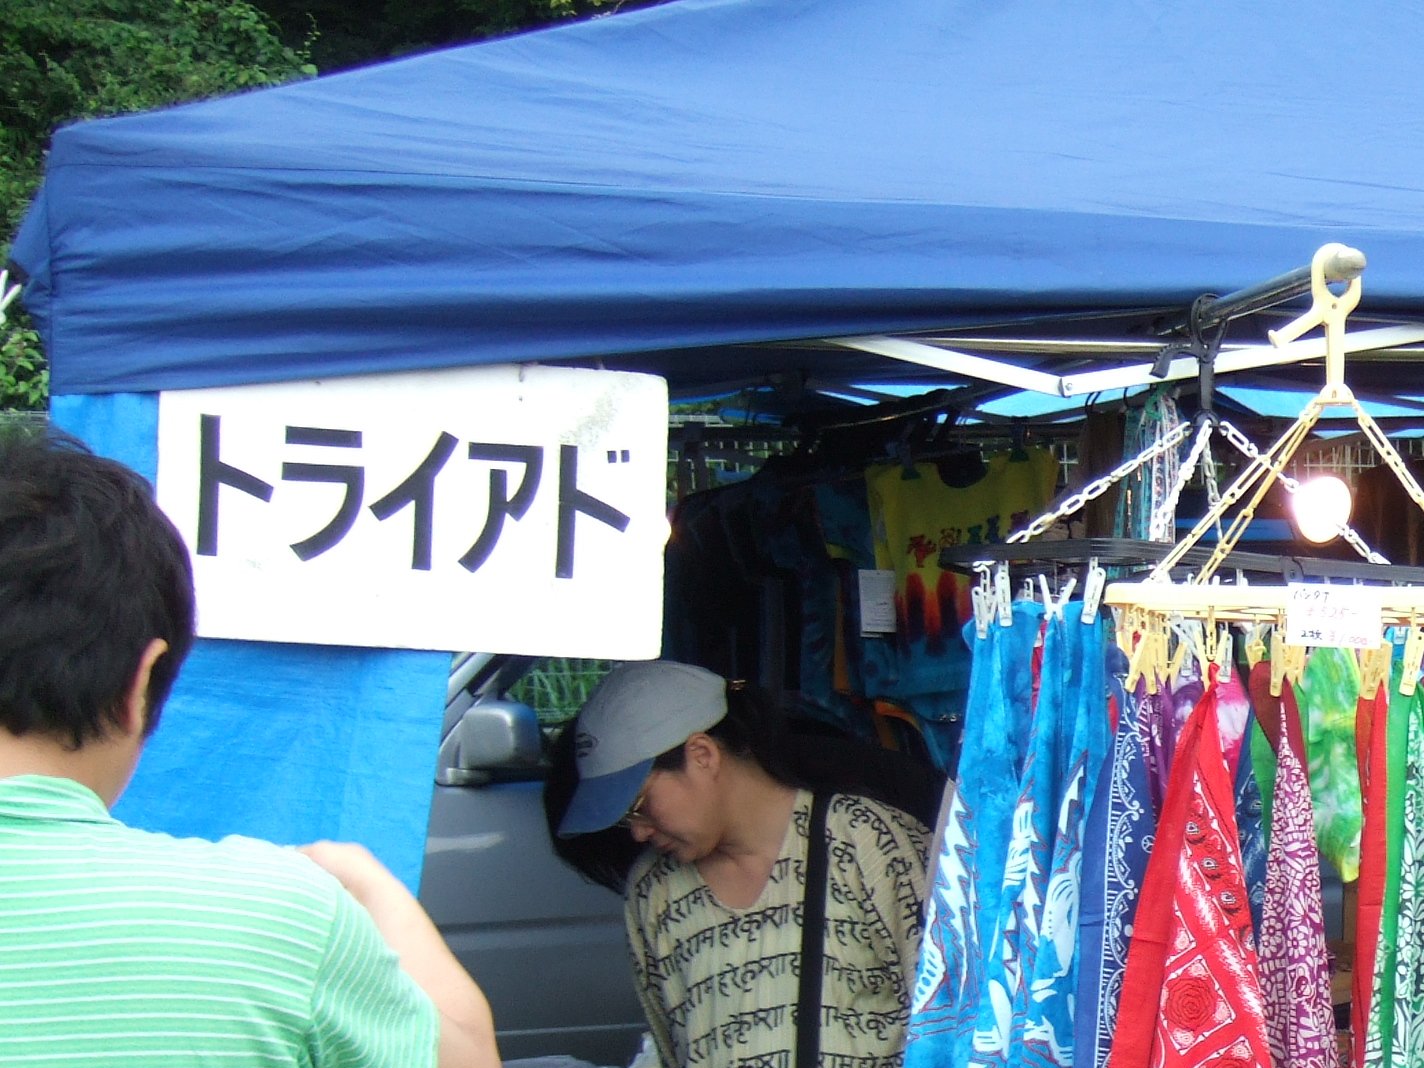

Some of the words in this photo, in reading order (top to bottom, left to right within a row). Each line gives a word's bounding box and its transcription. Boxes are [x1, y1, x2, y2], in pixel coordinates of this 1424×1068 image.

[196, 413, 631, 579] トライアド
